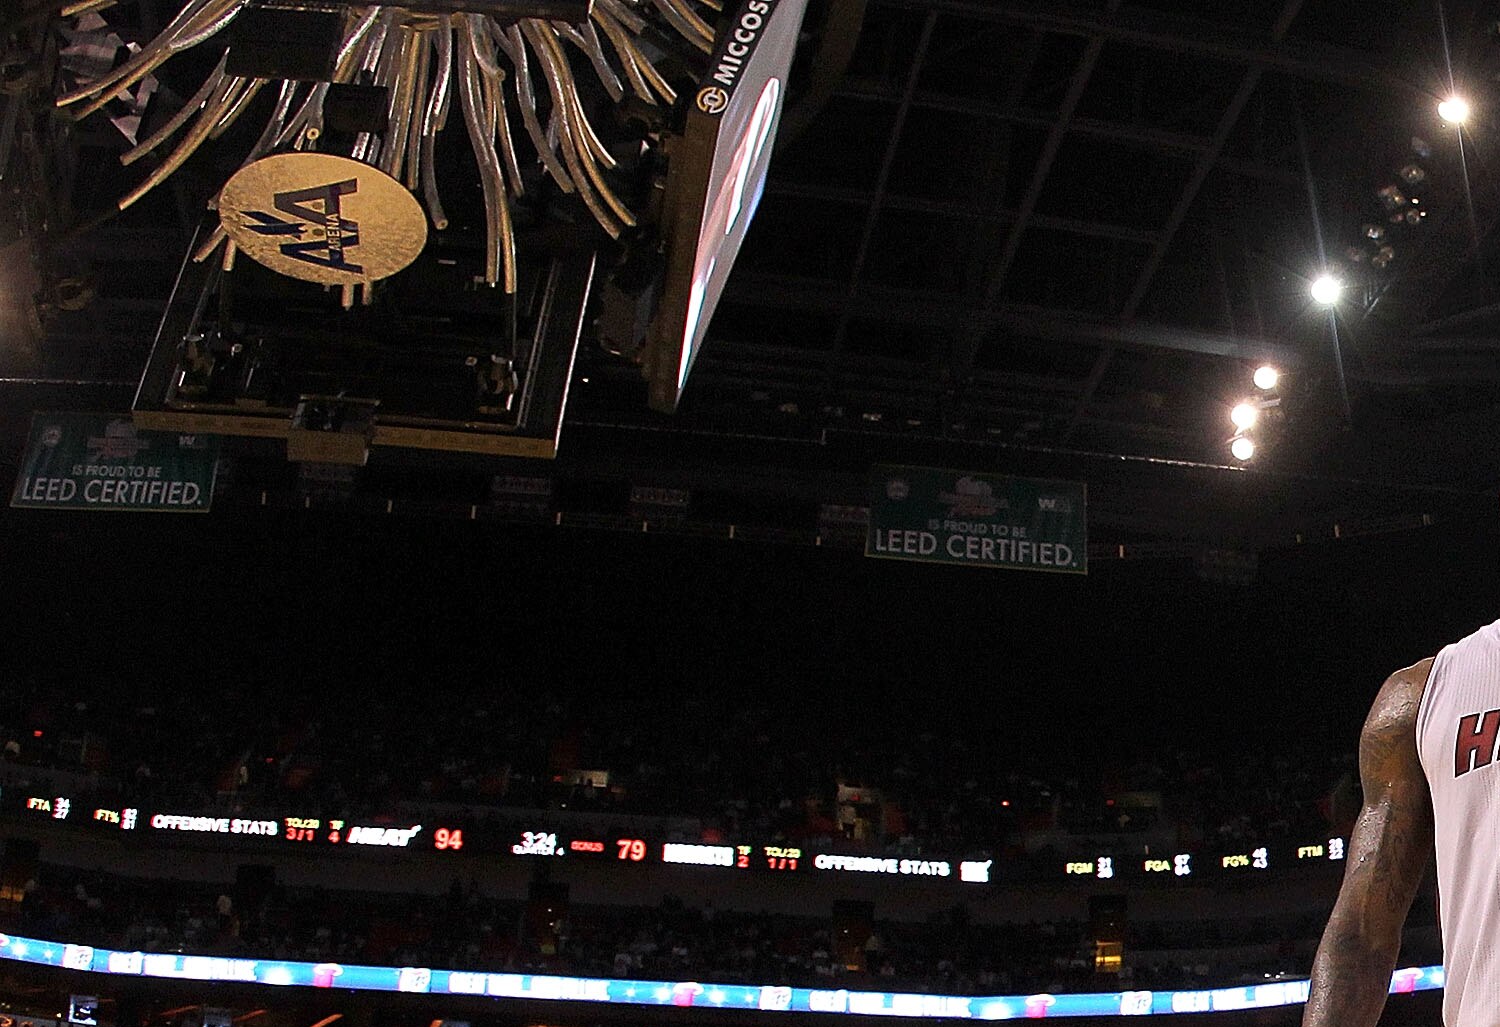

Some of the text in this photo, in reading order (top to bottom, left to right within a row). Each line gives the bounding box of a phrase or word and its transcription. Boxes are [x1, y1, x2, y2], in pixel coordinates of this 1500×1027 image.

[713, 0, 773, 86] MICCOS
[325, 213, 341, 251] ARENA
[72, 465, 162, 478] IS PROUD TO BE
[22, 477, 201, 504] LEED CERTIFIED.
[929, 519, 1027, 538] IS PROUD TO BE
[876, 529, 1078, 567] LEED CERTIFIED.
[27, 797, 50, 812] FTA
[152, 814, 278, 836] OFFENSIVE STATS
[328, 831, 340, 843] 4
[434, 828, 463, 849] 94
[616, 839, 646, 861] 79
[1298, 845, 1323, 858] FTM
[736, 856, 749, 868] 2
[814, 854, 898, 873] OFFENSIVE
[899, 859, 951, 876] STATS
[1065, 862, 1093, 875] FGM
[1144, 860, 1171, 873] FGA
[1222, 855, 1250, 868] FG%
